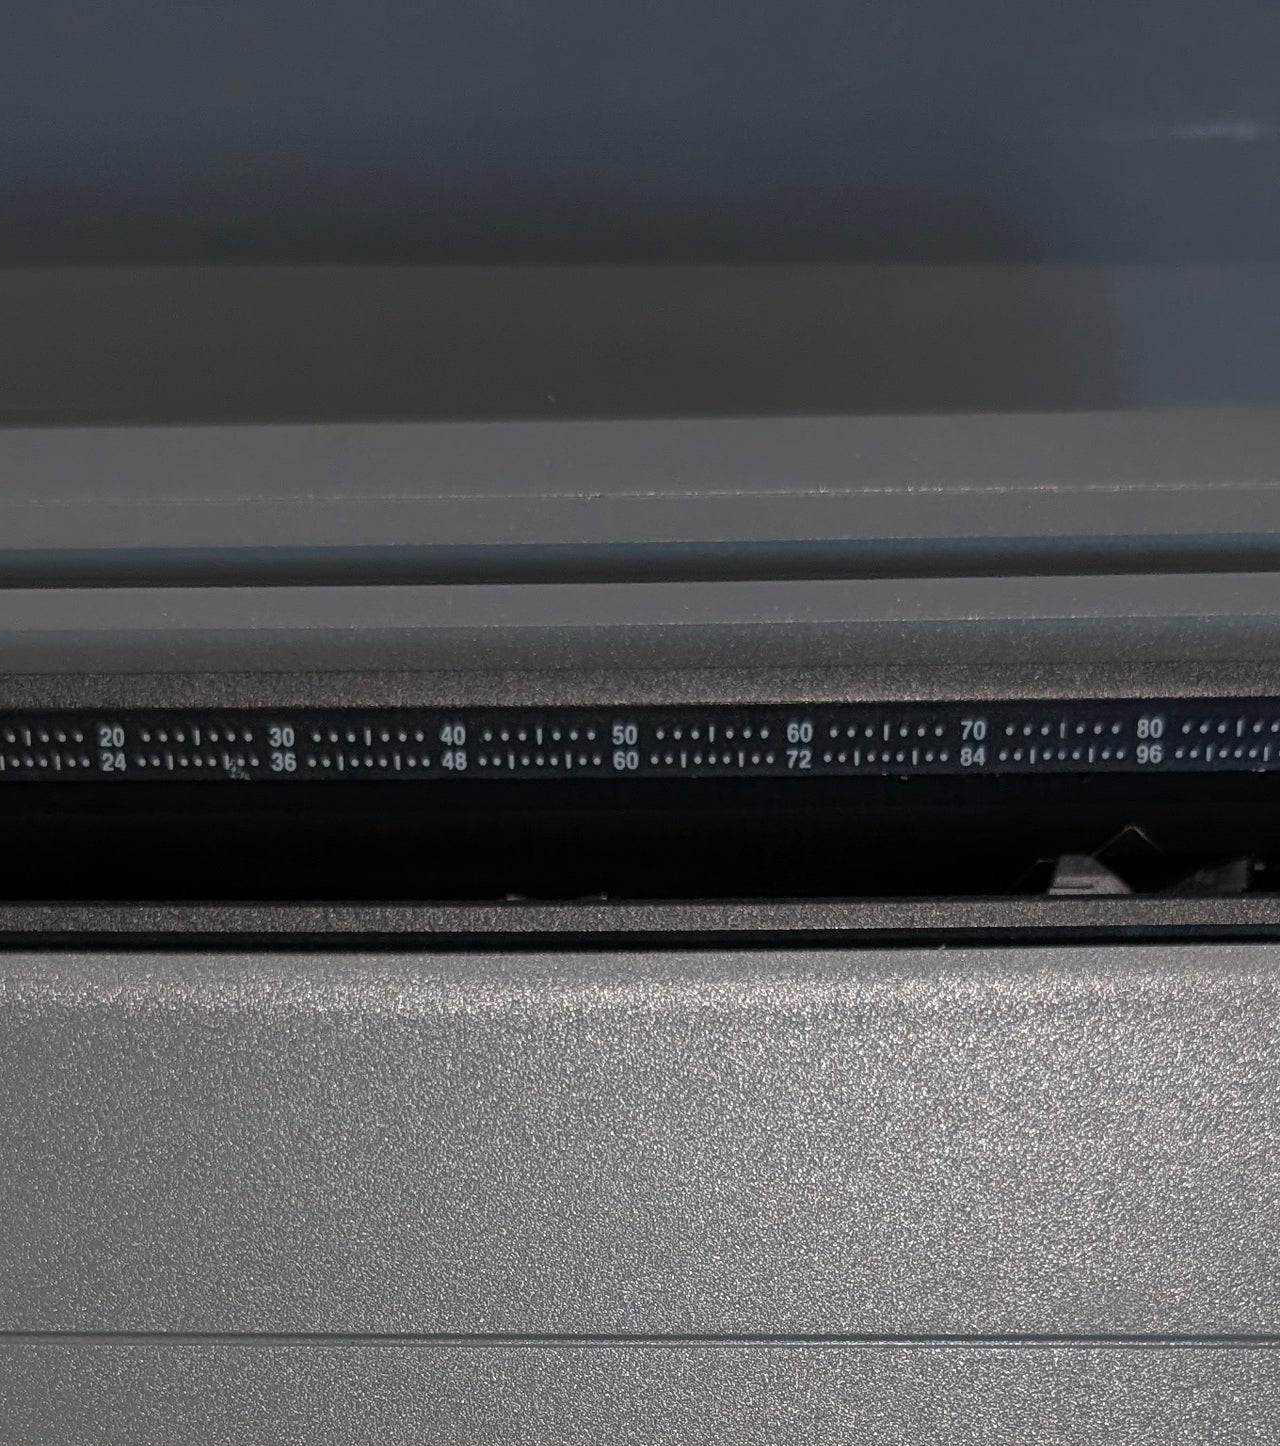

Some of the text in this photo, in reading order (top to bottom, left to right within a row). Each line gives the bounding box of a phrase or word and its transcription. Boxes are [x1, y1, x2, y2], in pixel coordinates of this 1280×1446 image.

[100, 727, 124, 747] 20
[270, 727, 294, 747] 30
[441, 725, 465, 745] 40
[613, 725, 637, 745] 50
[787, 722, 813, 743] 60
[961, 720, 986, 740] 70
[1137, 718, 1163, 738] 80
[102, 752, 126, 771] 24
[272, 752, 296, 771] 36
[442, 751, 467, 770] 48
[613, 751, 638, 770] 60
[787, 750, 811, 768] 72
[961, 747, 985, 766] 84
[1137, 744, 1162, 763] 96
